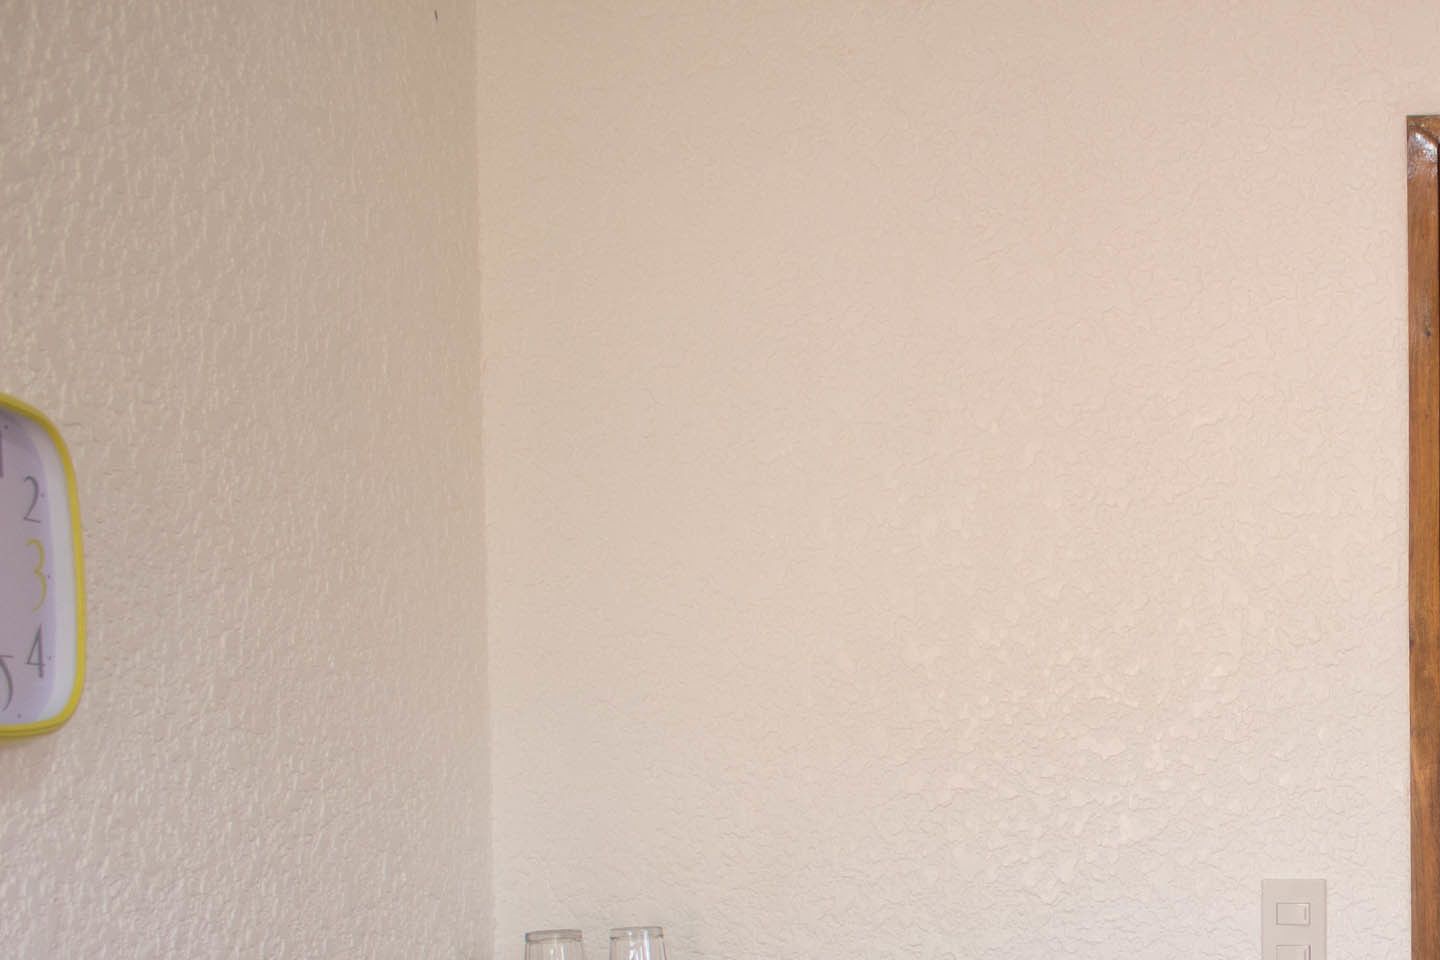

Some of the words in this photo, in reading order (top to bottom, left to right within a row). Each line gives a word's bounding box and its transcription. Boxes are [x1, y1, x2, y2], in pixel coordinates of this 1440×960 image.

[24, 475, 41, 524] 2
[25, 538, 48, 613] 3
[26, 623, 46, 678] 4
